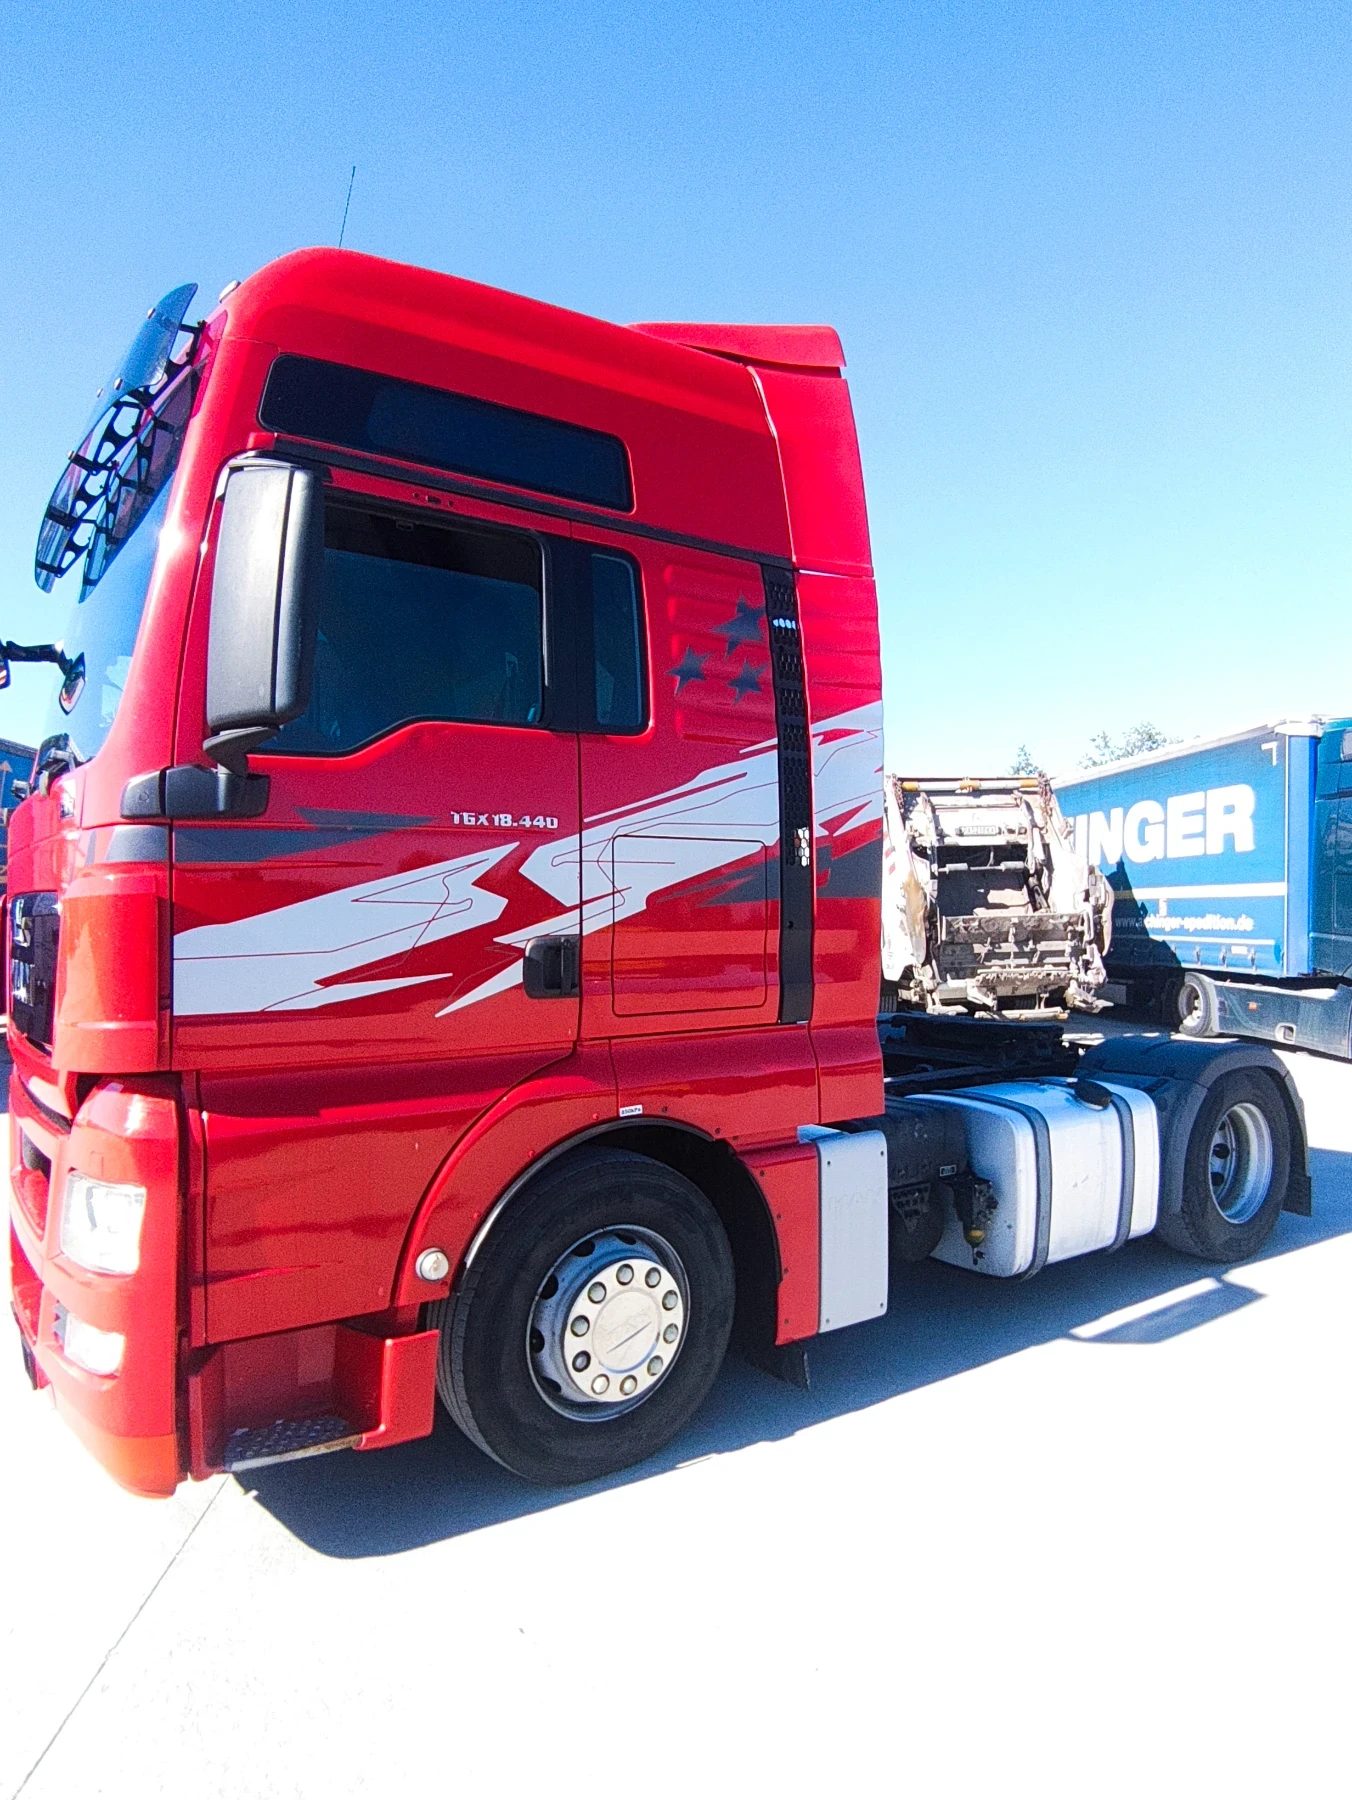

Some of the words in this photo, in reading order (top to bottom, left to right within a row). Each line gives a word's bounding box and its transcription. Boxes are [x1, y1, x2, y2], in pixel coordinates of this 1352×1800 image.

[450, 811, 489, 826] TGX
[491, 813, 559, 829] 18.440
[1067, 783, 1256, 866] INGER
